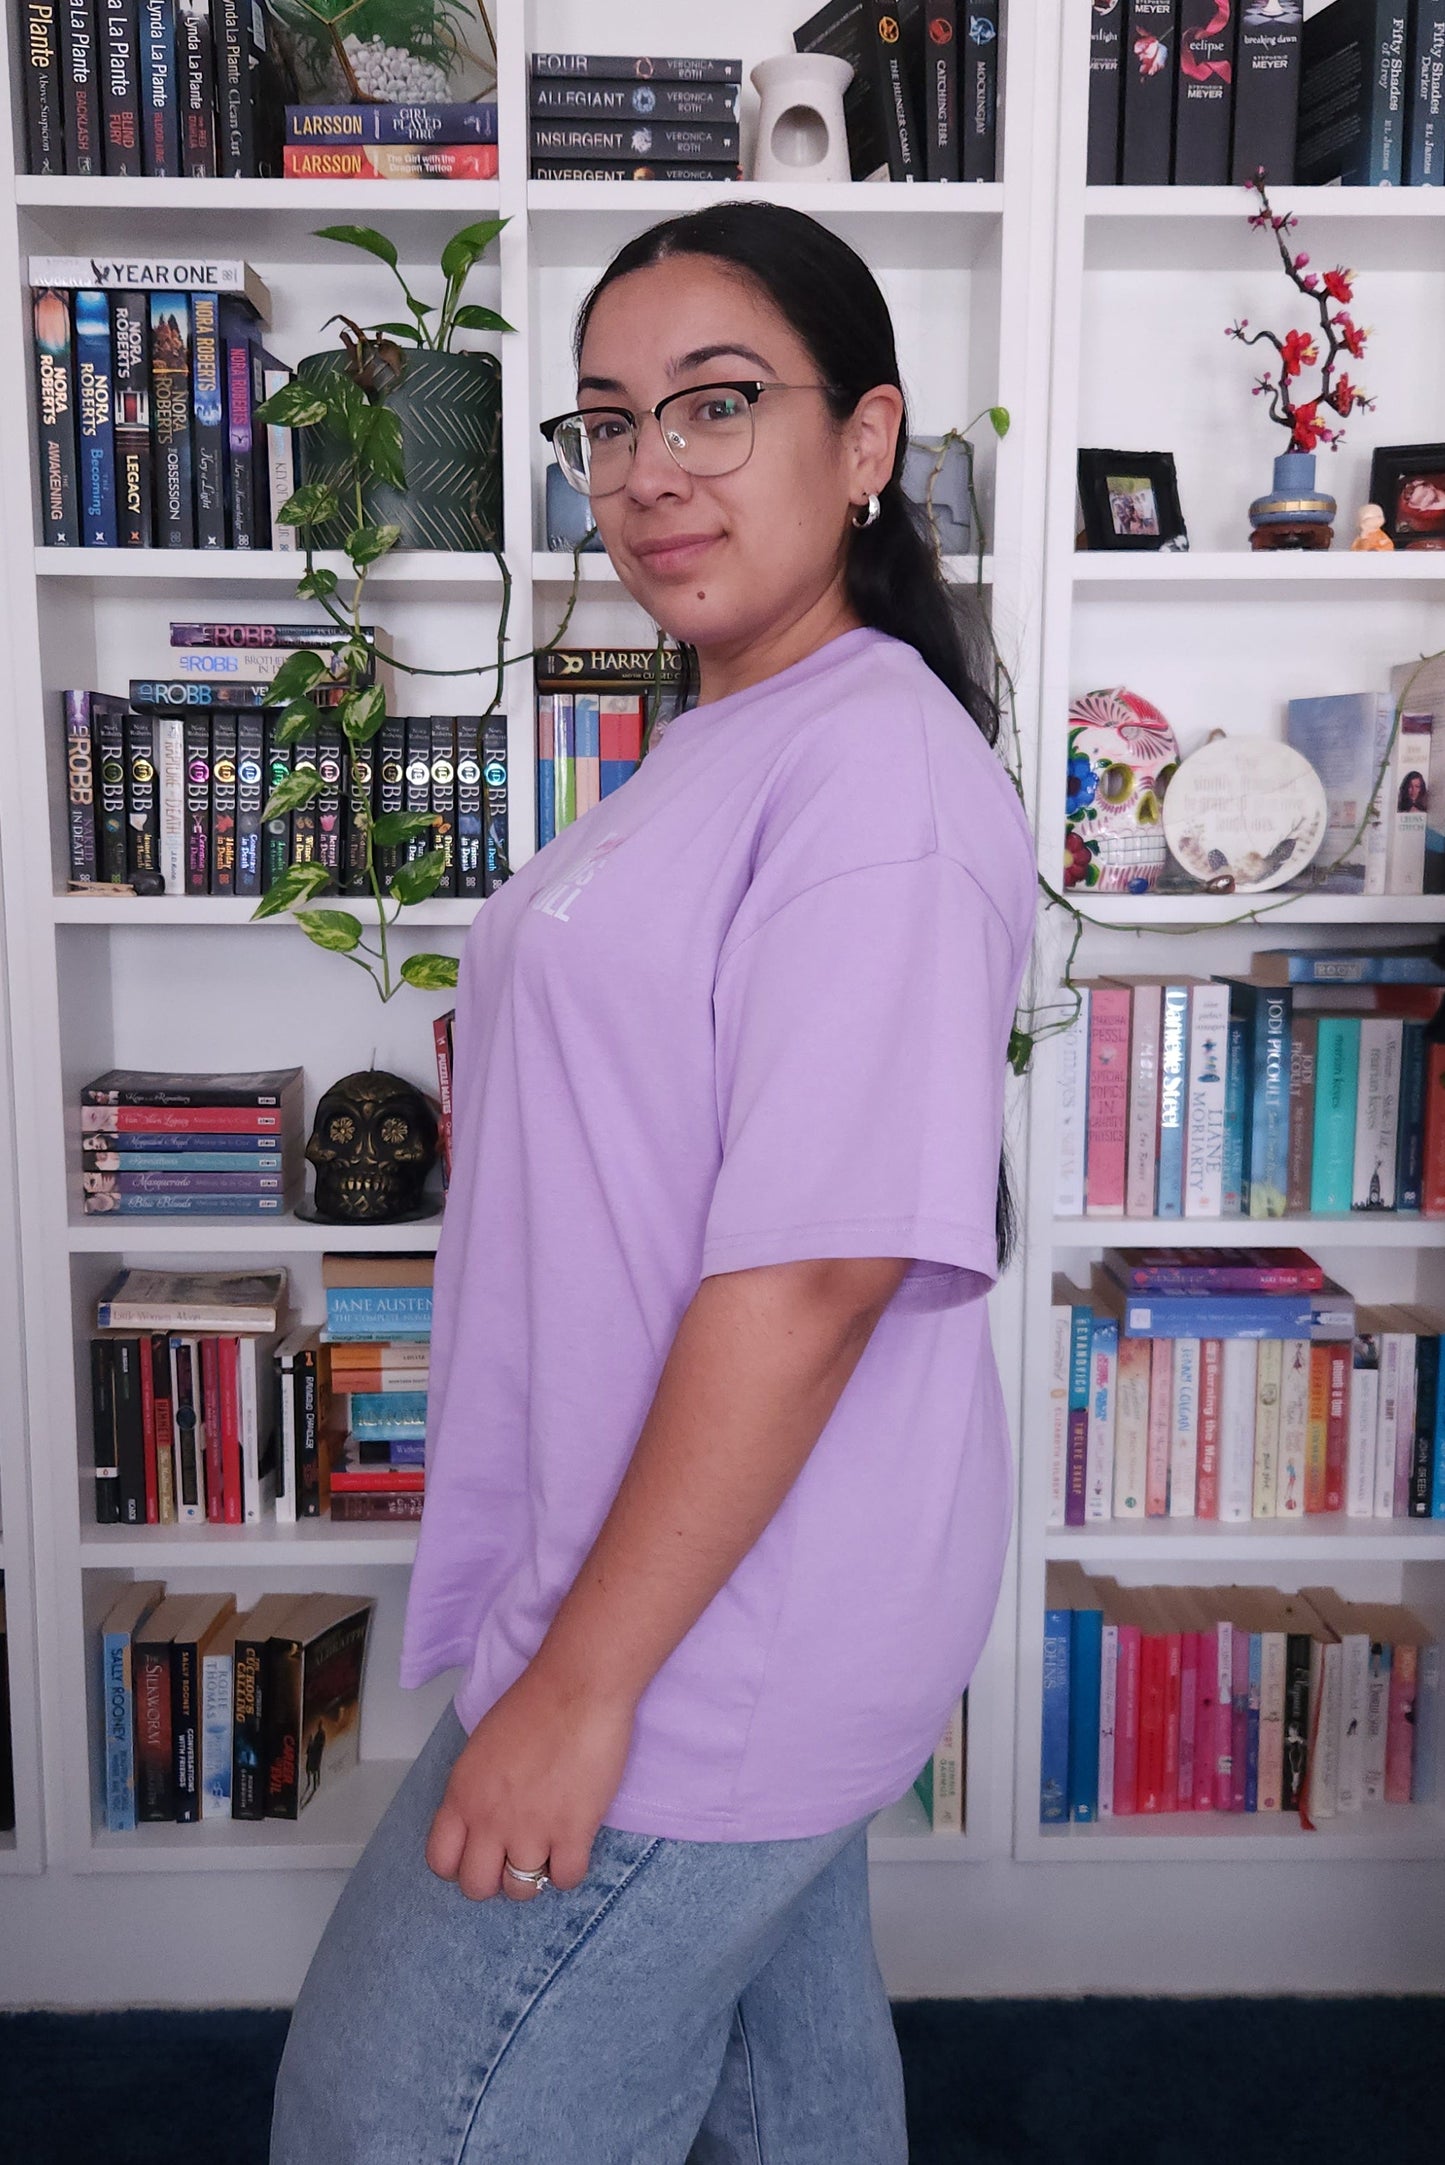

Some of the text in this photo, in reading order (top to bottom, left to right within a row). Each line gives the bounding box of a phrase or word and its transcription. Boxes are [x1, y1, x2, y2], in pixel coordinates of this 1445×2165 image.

[1135, 5, 1170, 13] MEYER
[29, 4, 54, 67] Plante
[70, 10, 89, 83] La Plante
[108, 17, 129, 96] La Plante
[147, 0, 168, 107] Lynda La Plante
[226, 29, 240, 84] La Plante
[1190, 42, 1224, 60] eclipse
[1244, 35, 1298, 51] breaking dawn
[185, 16, 204, 109] Lynda La Plante
[537, 56, 588, 71] FOUR
[667, 61, 714, 69] VERONICA
[678, 69, 702, 79] ROTH
[1253, 60, 1288, 69] MEYER
[1379, 42, 1391, 89] of Grey
[1389, 18, 1403, 111] Fifty Shades
[1420, 56, 1431, 100] Darker
[1430, 22, 1445, 115] Fifty Shades
[38, 73, 51, 151] Above Suspicion
[229, 89, 241, 128] Clean
[400, 108, 427, 119] GIRL
[537, 91, 625, 107] ALLEGIANT
[667, 92, 713, 101] VERONICA
[678, 102, 702, 113] ROTH
[889, 59, 912, 164] THE HUNGER GAMES
[937, 60, 947, 148] CATCHING FIRE
[975, 61, 987, 135] MOCKINGJAY
[1188, 90, 1223, 99] MEYER
[75, 91, 89, 150] BACKLASH
[108, 114, 122, 145] FURY
[121, 111, 134, 148] BLIND
[293, 115, 362, 135] LARSSON
[392, 119, 442, 130] PLAYED
[409, 129, 434, 140] FIRE
[536, 131, 623, 149] INSURGENT
[666, 132, 712, 141] VERONICA
[292, 155, 361, 173] LARSSON
[387, 155, 455, 164] The Girl with the
[677, 142, 700, 152] ROTH
[666, 171, 713, 180] VERONICA
[112, 264, 218, 283] YEAR ONE
[116, 307, 131, 379] ROBERTS
[128, 321, 142, 366] NORA
[195, 300, 217, 392] NORA ROBERTS
[40, 354, 56, 425] ROBERTS
[55, 367, 69, 413] NORA
[80, 363, 97, 436] ROBERTS
[95, 375, 109, 424] NORA
[230, 348, 248, 425] NORA ROBERTS
[156, 377, 173, 444] ROBERTS
[172, 391, 187, 432] NORA
[47, 441, 63, 520] AWAKENING
[89, 448, 104, 516] Becoming
[125, 454, 140, 514] LEGACY
[167, 453, 180, 520] OBSESSION
[201, 480, 214, 510] Light
[214, 625, 276, 647] ROBB
[189, 656, 238, 672] ROBB
[591, 651, 653, 670] HARRY
[156, 684, 212, 705] ROBB
[68, 737, 93, 805] ROBB
[188, 745, 209, 812] ROBB
[214, 746, 236, 812] ROBB
[238, 747, 261, 813] ROBB
[381, 747, 403, 813] ROBB
[431, 746, 454, 813] ROBB
[72, 811, 84, 866] IN DEATH
[82, 818, 94, 861] NAKED
[217, 846, 226, 870] Death
[224, 836, 234, 870] Holiday
[241, 848, 249, 868] Death
[248, 834, 258, 873] Conspiracy
[329, 835, 337, 867] Betrayal
[444, 835, 453, 867] Divided
[461, 848, 471, 871] Death
[470, 839, 479, 869] Visions
[488, 851, 498, 871] Death
[1266, 999, 1283, 1034] JODI
[1162, 992, 1187, 1128] Danielle Steel
[1265, 1039, 1282, 1107] PICOULT
[1289, 1042, 1303, 1098] PICOULT
[1301, 1054, 1313, 1084] JODI
[438, 1053, 451, 1114] PUZZLE MATES
[1367, 1047, 1382, 1131] marian keyes
[1190, 1091, 1205, 1192] MORIARTY
[1206, 1109, 1223, 1174] LIANE
[332, 1298, 433, 1312] JANE AUSTEN
[1074, 1326, 1090, 1394] EVANOVICH
[305, 1413, 315, 1448] CHANDLER
[1202, 1364, 1217, 1472] Burning the Map
[1417, 1438, 1428, 1497] JOHN GREEN
[109, 1648, 124, 1683] SALLY
[182, 1651, 190, 1716] SALLY ROONEY
[245, 1648, 256, 1715] CUCKOO'S
[1044, 1636, 1057, 1689] JOHNS
[145, 1664, 163, 1745] SILKWORM
[206, 1661, 218, 1719] THOMAS
[235, 1662, 246, 1723] CALLING
[112, 1687, 126, 1742] ROONEY
[270, 1767, 282, 1794] EVIL
[283, 1735, 295, 1784] CAREER
